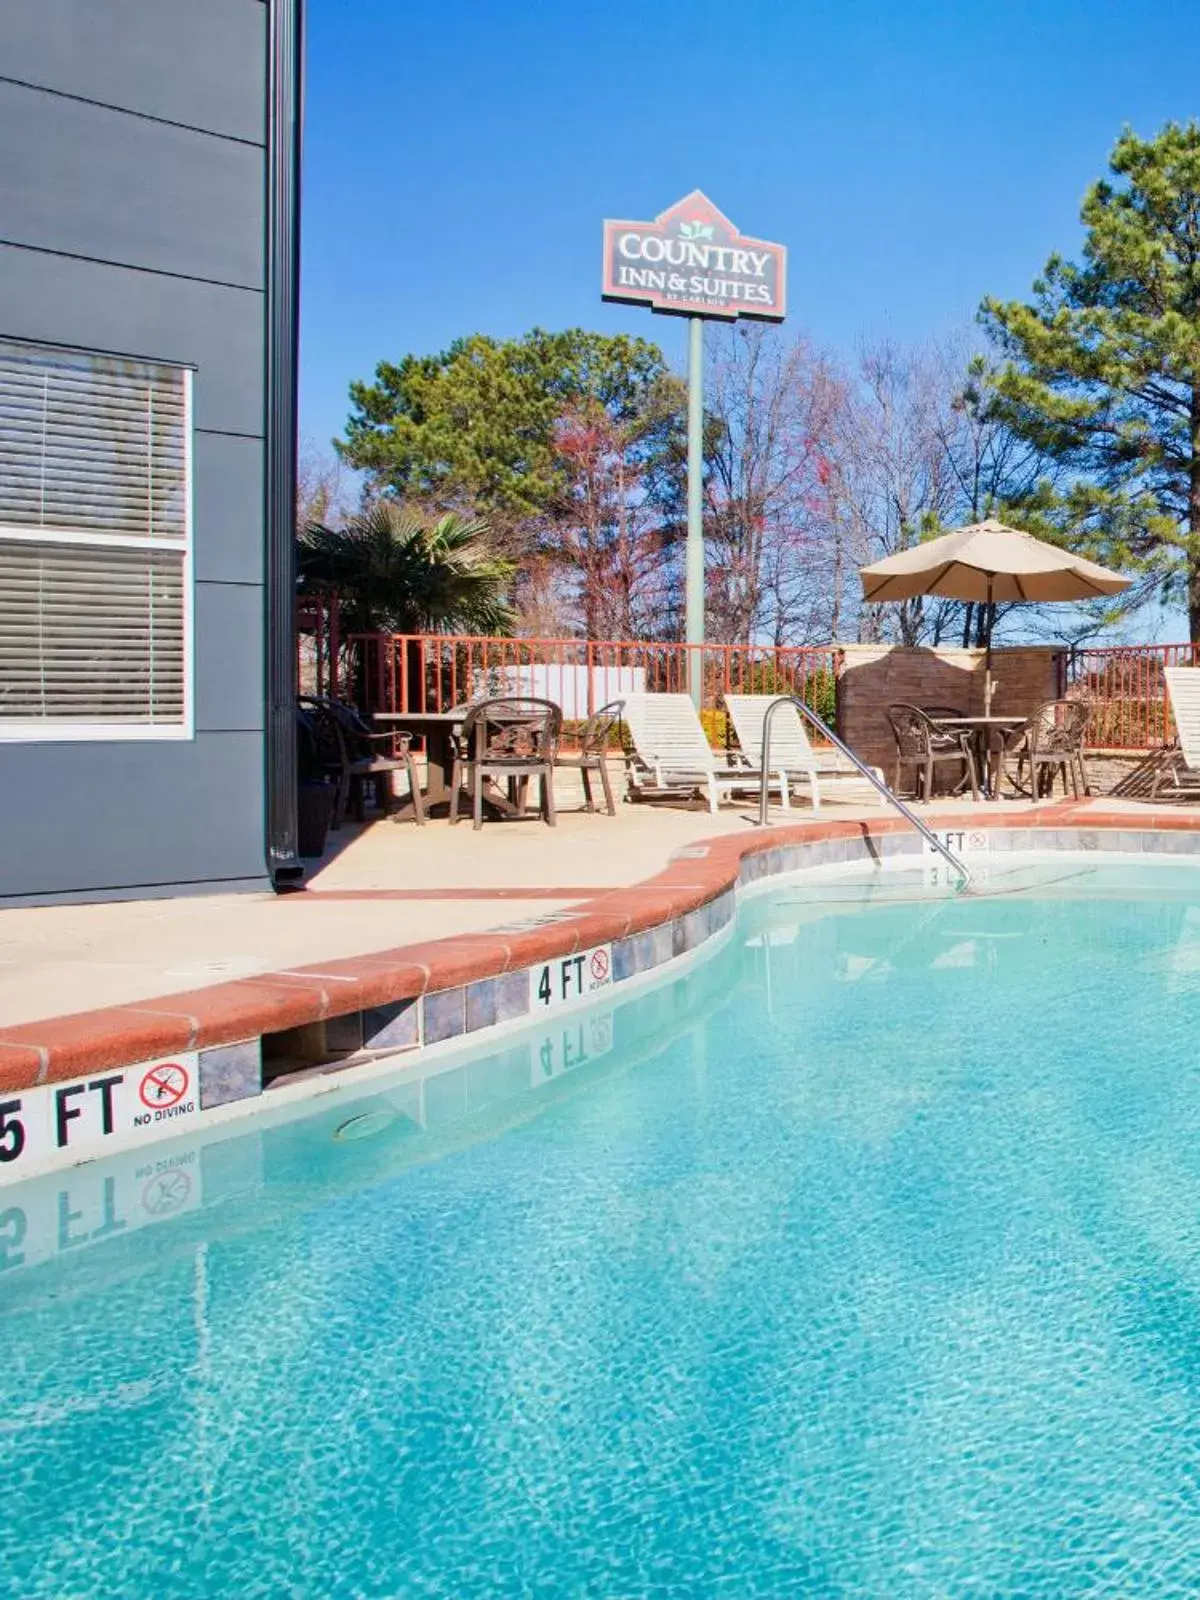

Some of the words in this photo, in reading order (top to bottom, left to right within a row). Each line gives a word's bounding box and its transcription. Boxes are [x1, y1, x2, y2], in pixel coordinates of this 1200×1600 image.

[618, 233, 771, 277] COUNTRY
[946, 832, 965, 852] FT
[538, 965, 552, 1005] 4
[561, 955, 586, 1000] FT
[0, 1099, 26, 1162] 5
[56, 1075, 124, 1147] FT
[134, 1114, 152, 1127] NO
[155, 1102, 195, 1121] DIVING
